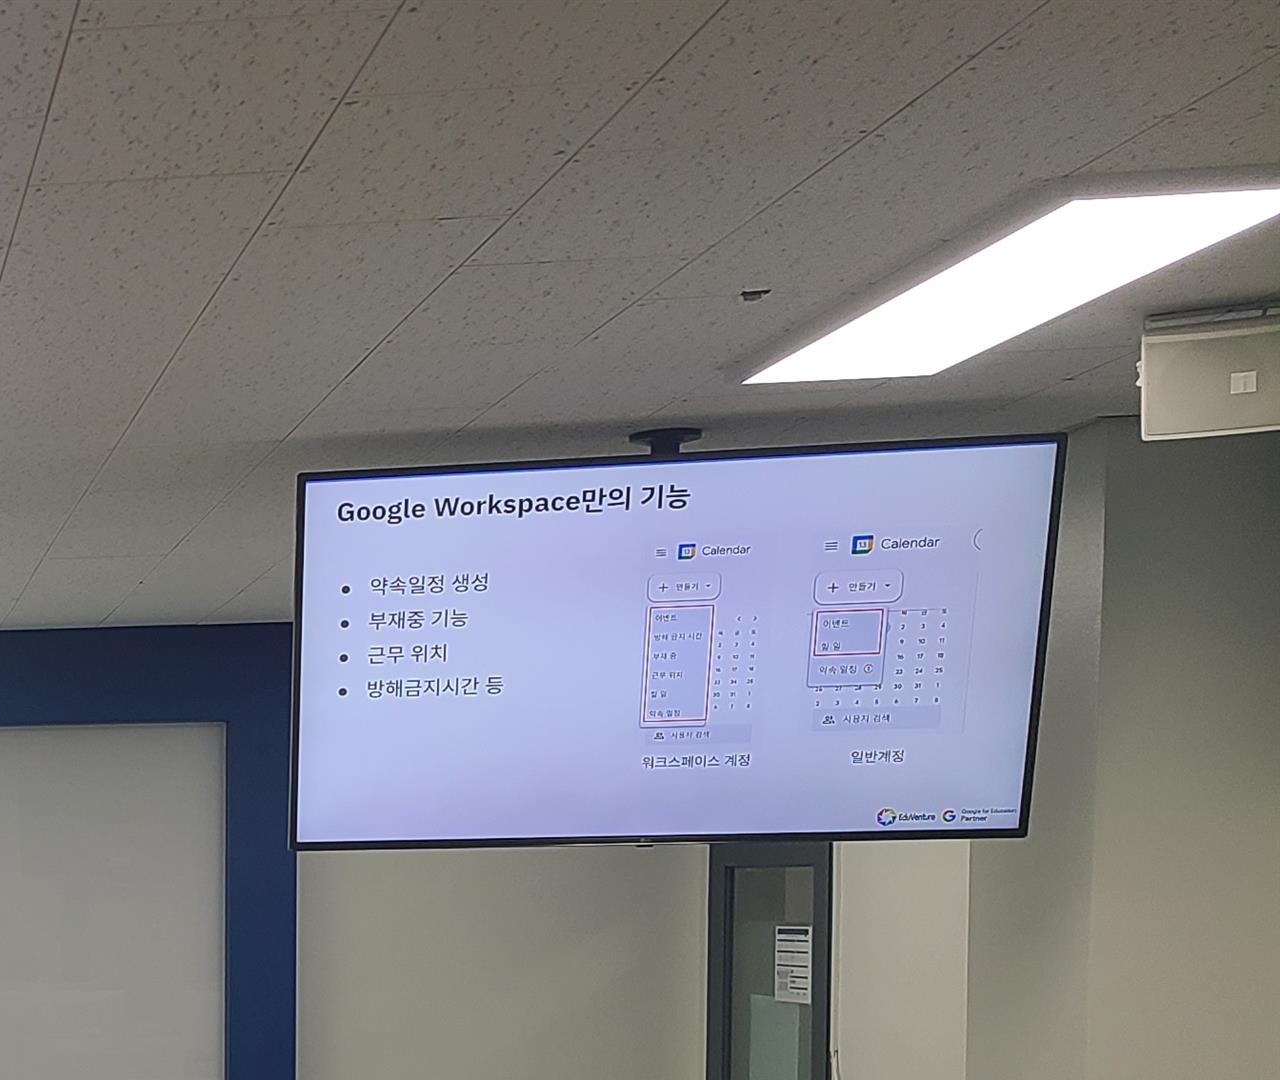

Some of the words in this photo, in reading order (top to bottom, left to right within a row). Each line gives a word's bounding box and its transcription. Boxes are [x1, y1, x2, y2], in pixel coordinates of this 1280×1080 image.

[338, 498, 426, 524] Google
[434, 486, 631, 518] Workspace만의
[641, 485, 691, 510] 기능
[702, 545, 752, 556] Calendar
[881, 537, 940, 549] Calendar
[370, 576, 445, 597] 약속일정
[451, 573, 490, 593] 생성
[369, 612, 424, 630] 부재중
[431, 609, 468, 628] 기능
[367, 646, 405, 665] 근무
[411, 643, 448, 663] 위치
[366, 677, 480, 698] 방해금지시간
[485, 675, 504, 695] 등
[642, 756, 719, 770] 워크스페이스
[724, 754, 751, 768] 계정
[851, 749, 904, 764] 일반계정
